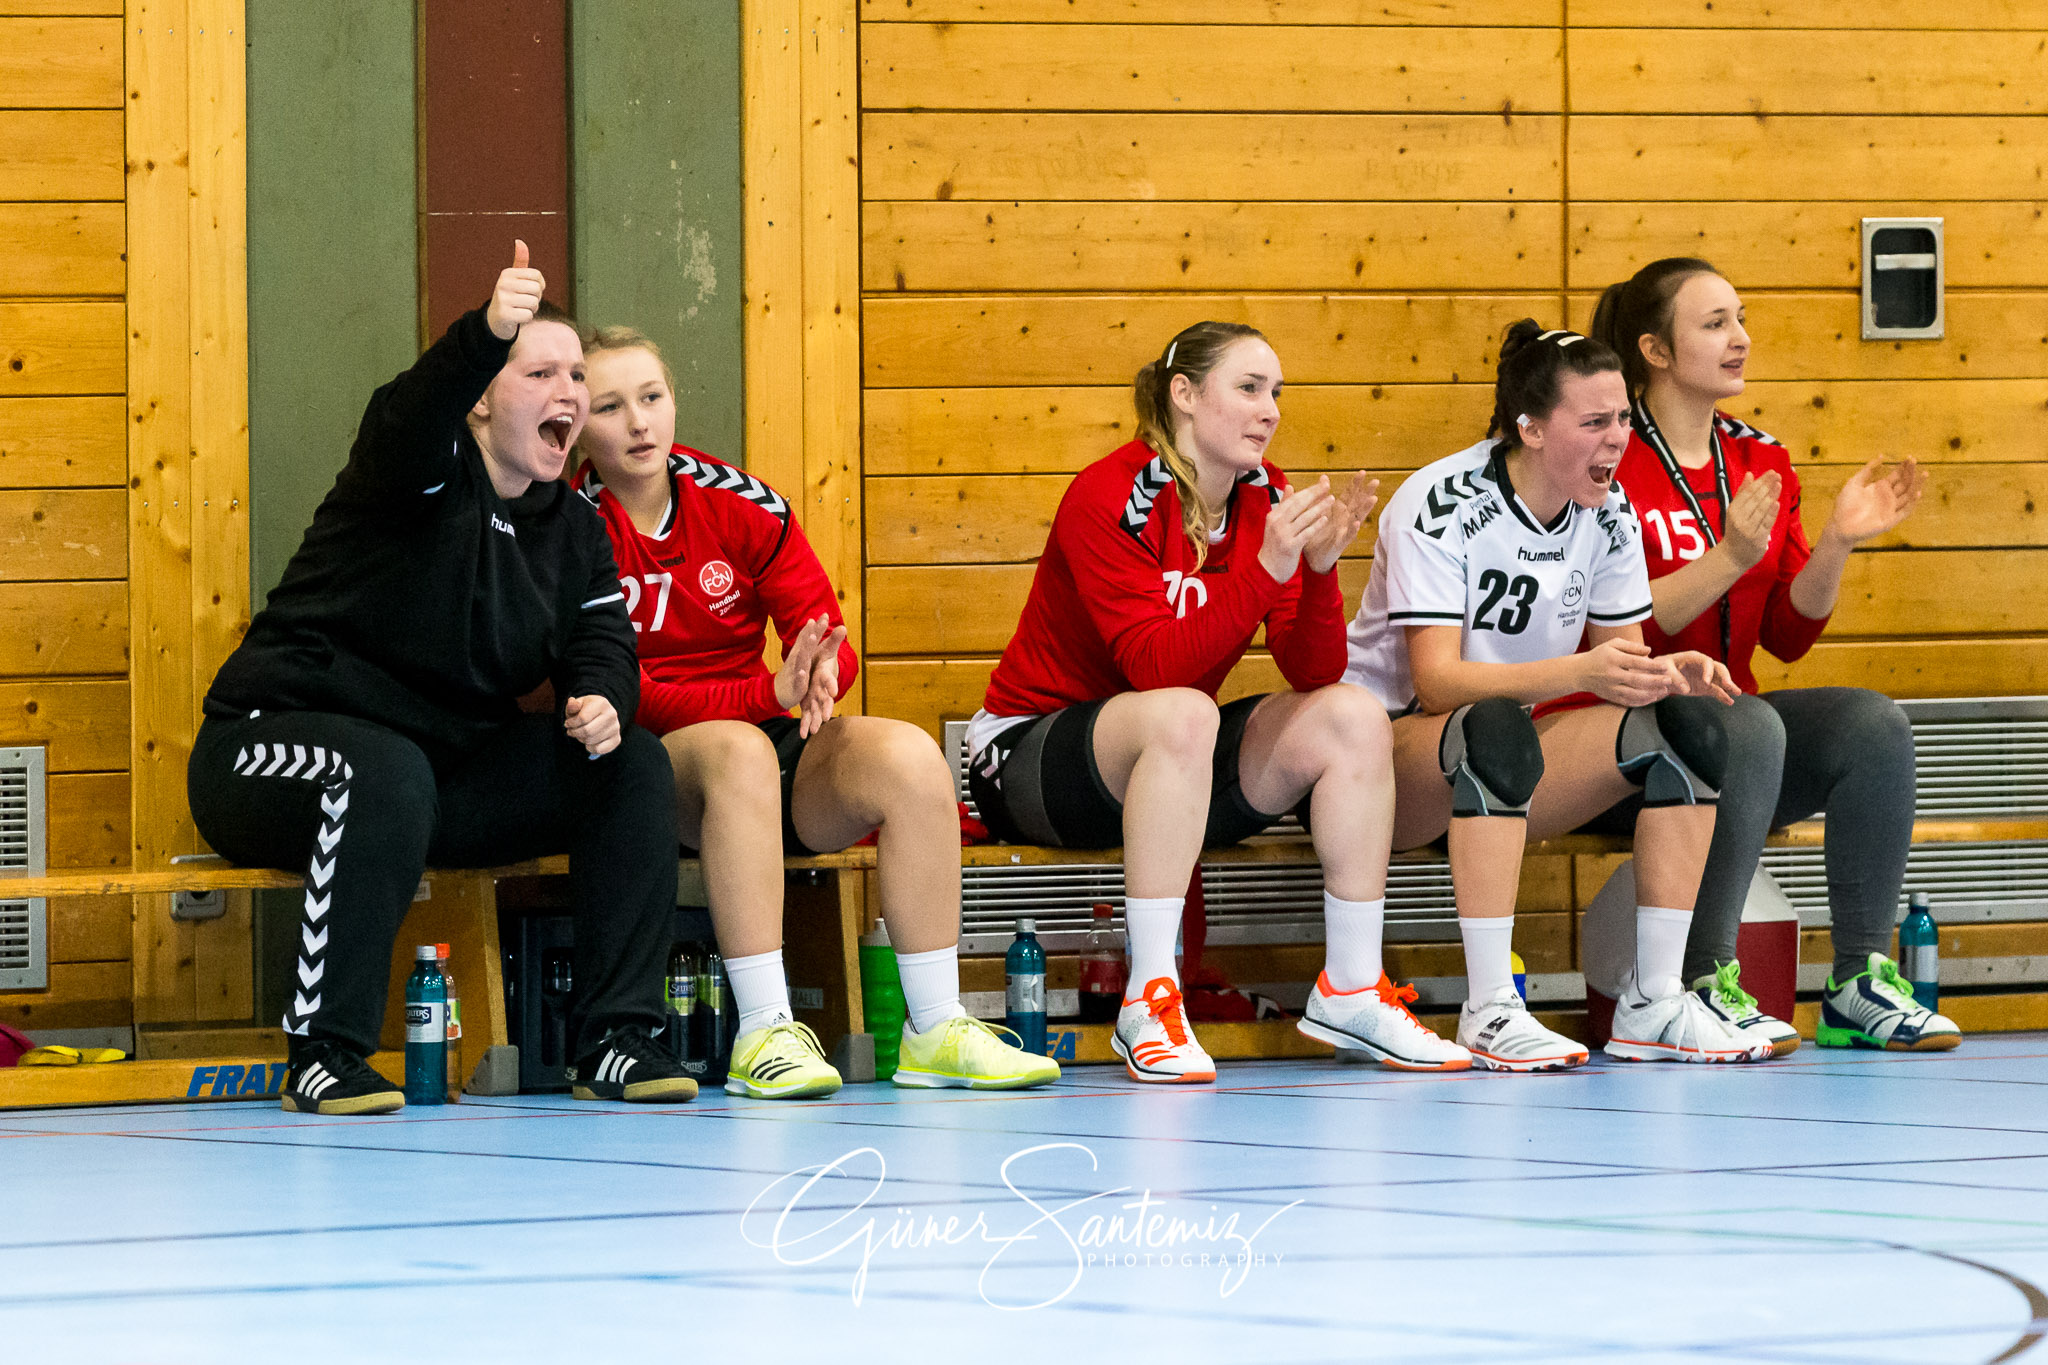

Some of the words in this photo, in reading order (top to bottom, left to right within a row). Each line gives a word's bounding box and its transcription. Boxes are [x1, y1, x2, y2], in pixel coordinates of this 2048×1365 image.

[1463, 499, 1502, 539] MAN
[1645, 508, 1705, 561] 15
[1517, 546, 1565, 562] hummel
[704, 570, 731, 592] FCN
[1564, 585, 1582, 599] FCN
[619, 571, 673, 632] 27
[708, 589, 741, 612] Handball
[1471, 568, 1540, 636] 23
